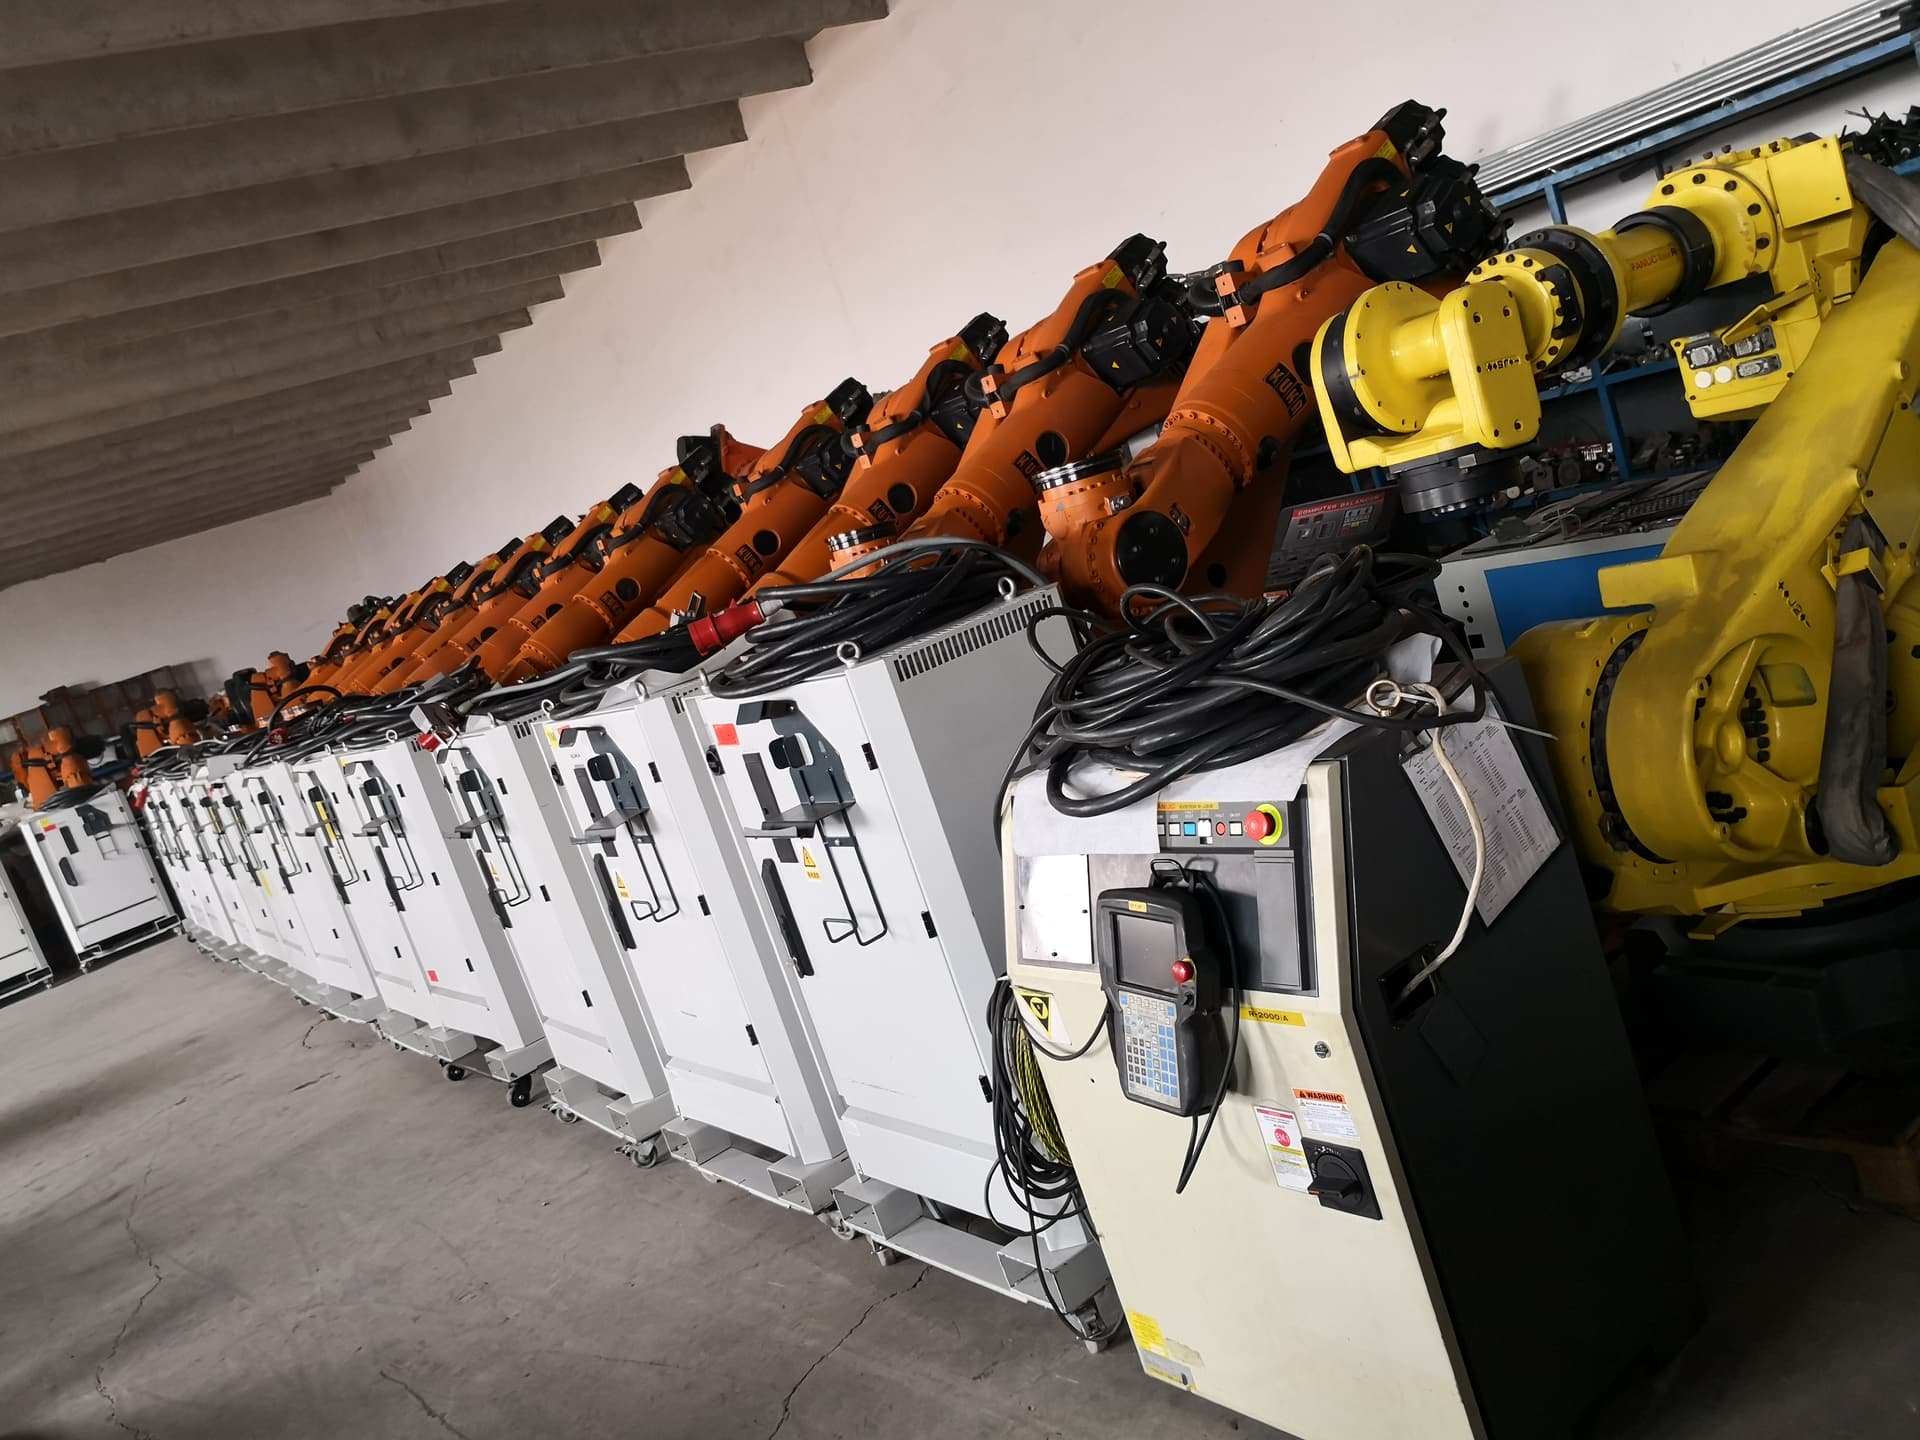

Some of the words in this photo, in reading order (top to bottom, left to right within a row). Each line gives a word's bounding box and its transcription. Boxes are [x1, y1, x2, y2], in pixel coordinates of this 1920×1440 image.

[1631, 255, 1658, 271] FANUC
[1267, 366, 1305, 417] KUKA
[1298, 504, 1337, 516] COMPUTER
[1306, 1092, 1343, 1103] WARNING
